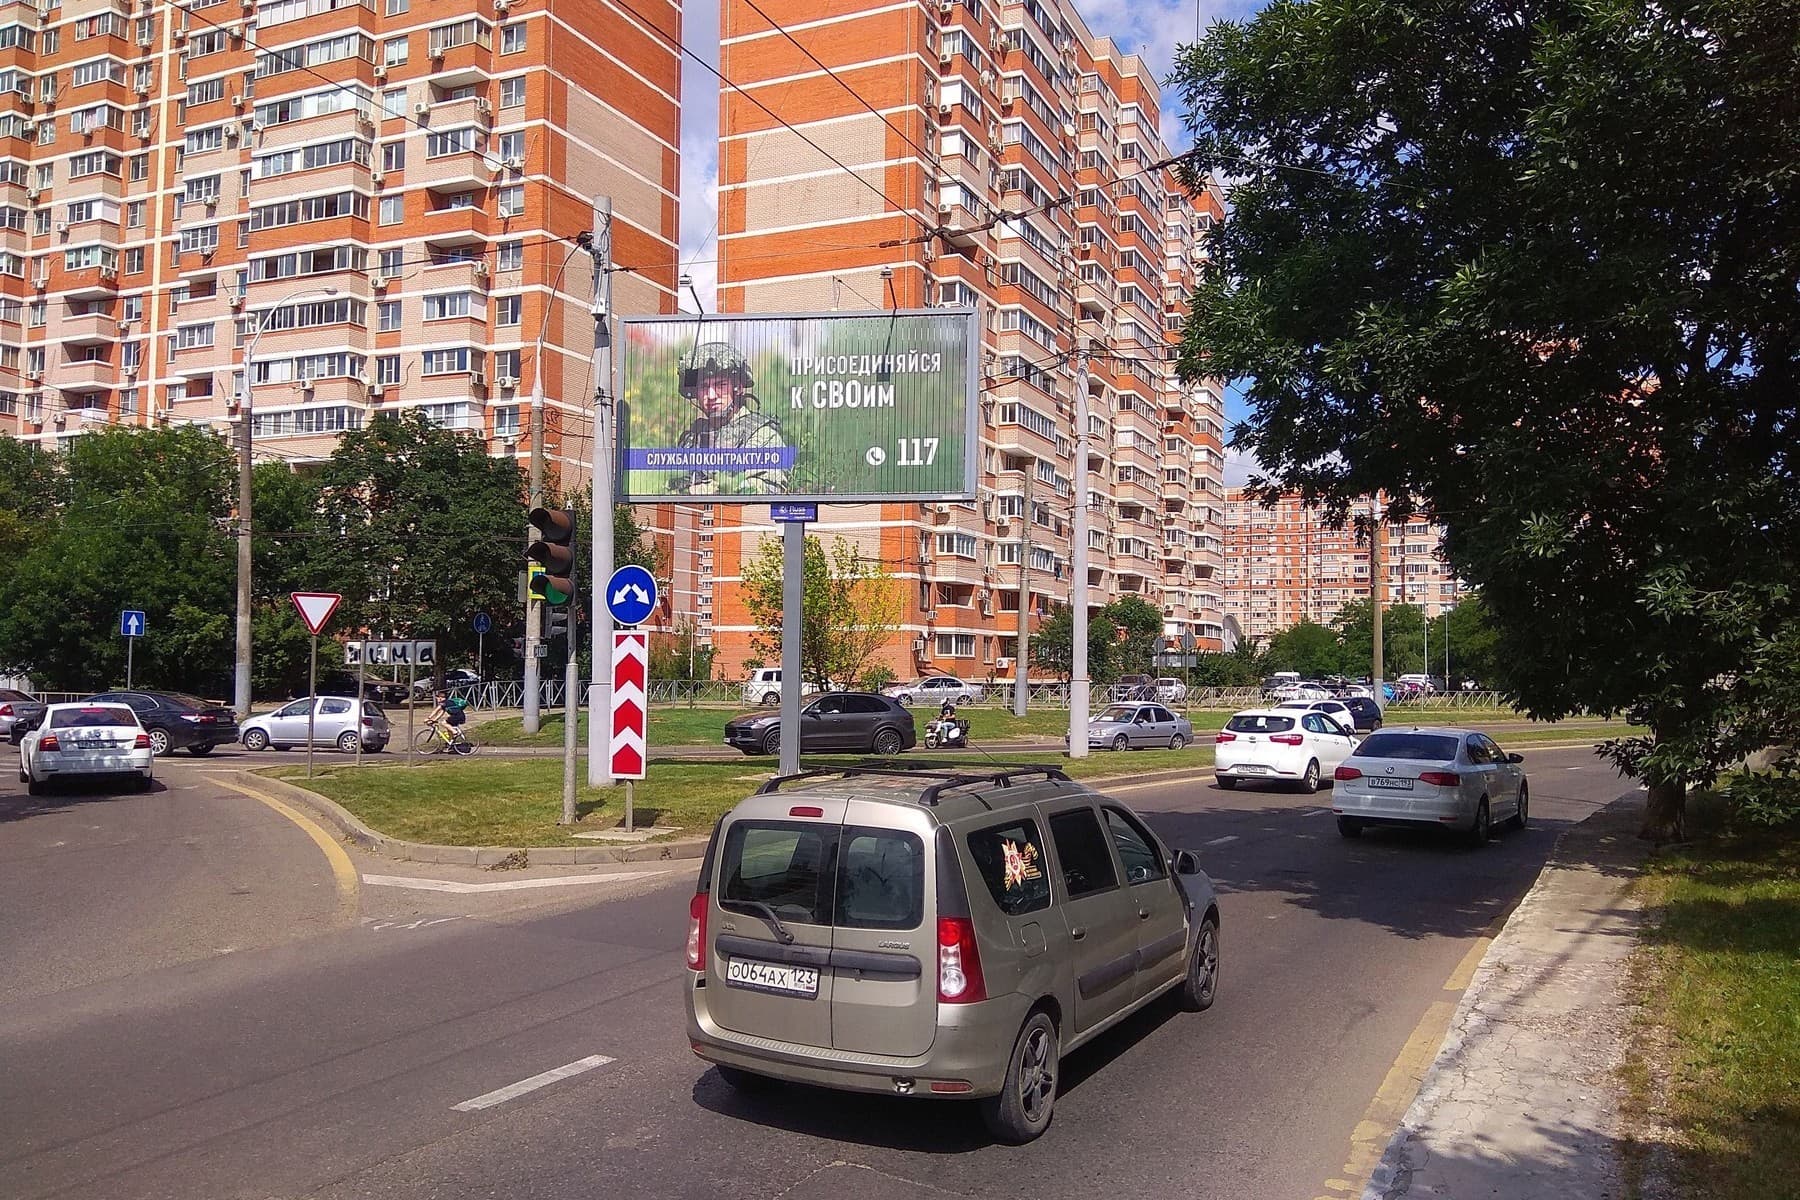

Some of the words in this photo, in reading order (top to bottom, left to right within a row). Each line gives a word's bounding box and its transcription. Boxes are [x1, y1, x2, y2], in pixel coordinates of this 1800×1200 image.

[791, 349, 941, 376] ПРИСОЕДИНЯЙСЯ
[647, 451, 780, 465] СЛУЖБАПОКОНТРАКТУ.РФ
[897, 437, 939, 466] 117
[791, 967, 814, 984] 123
